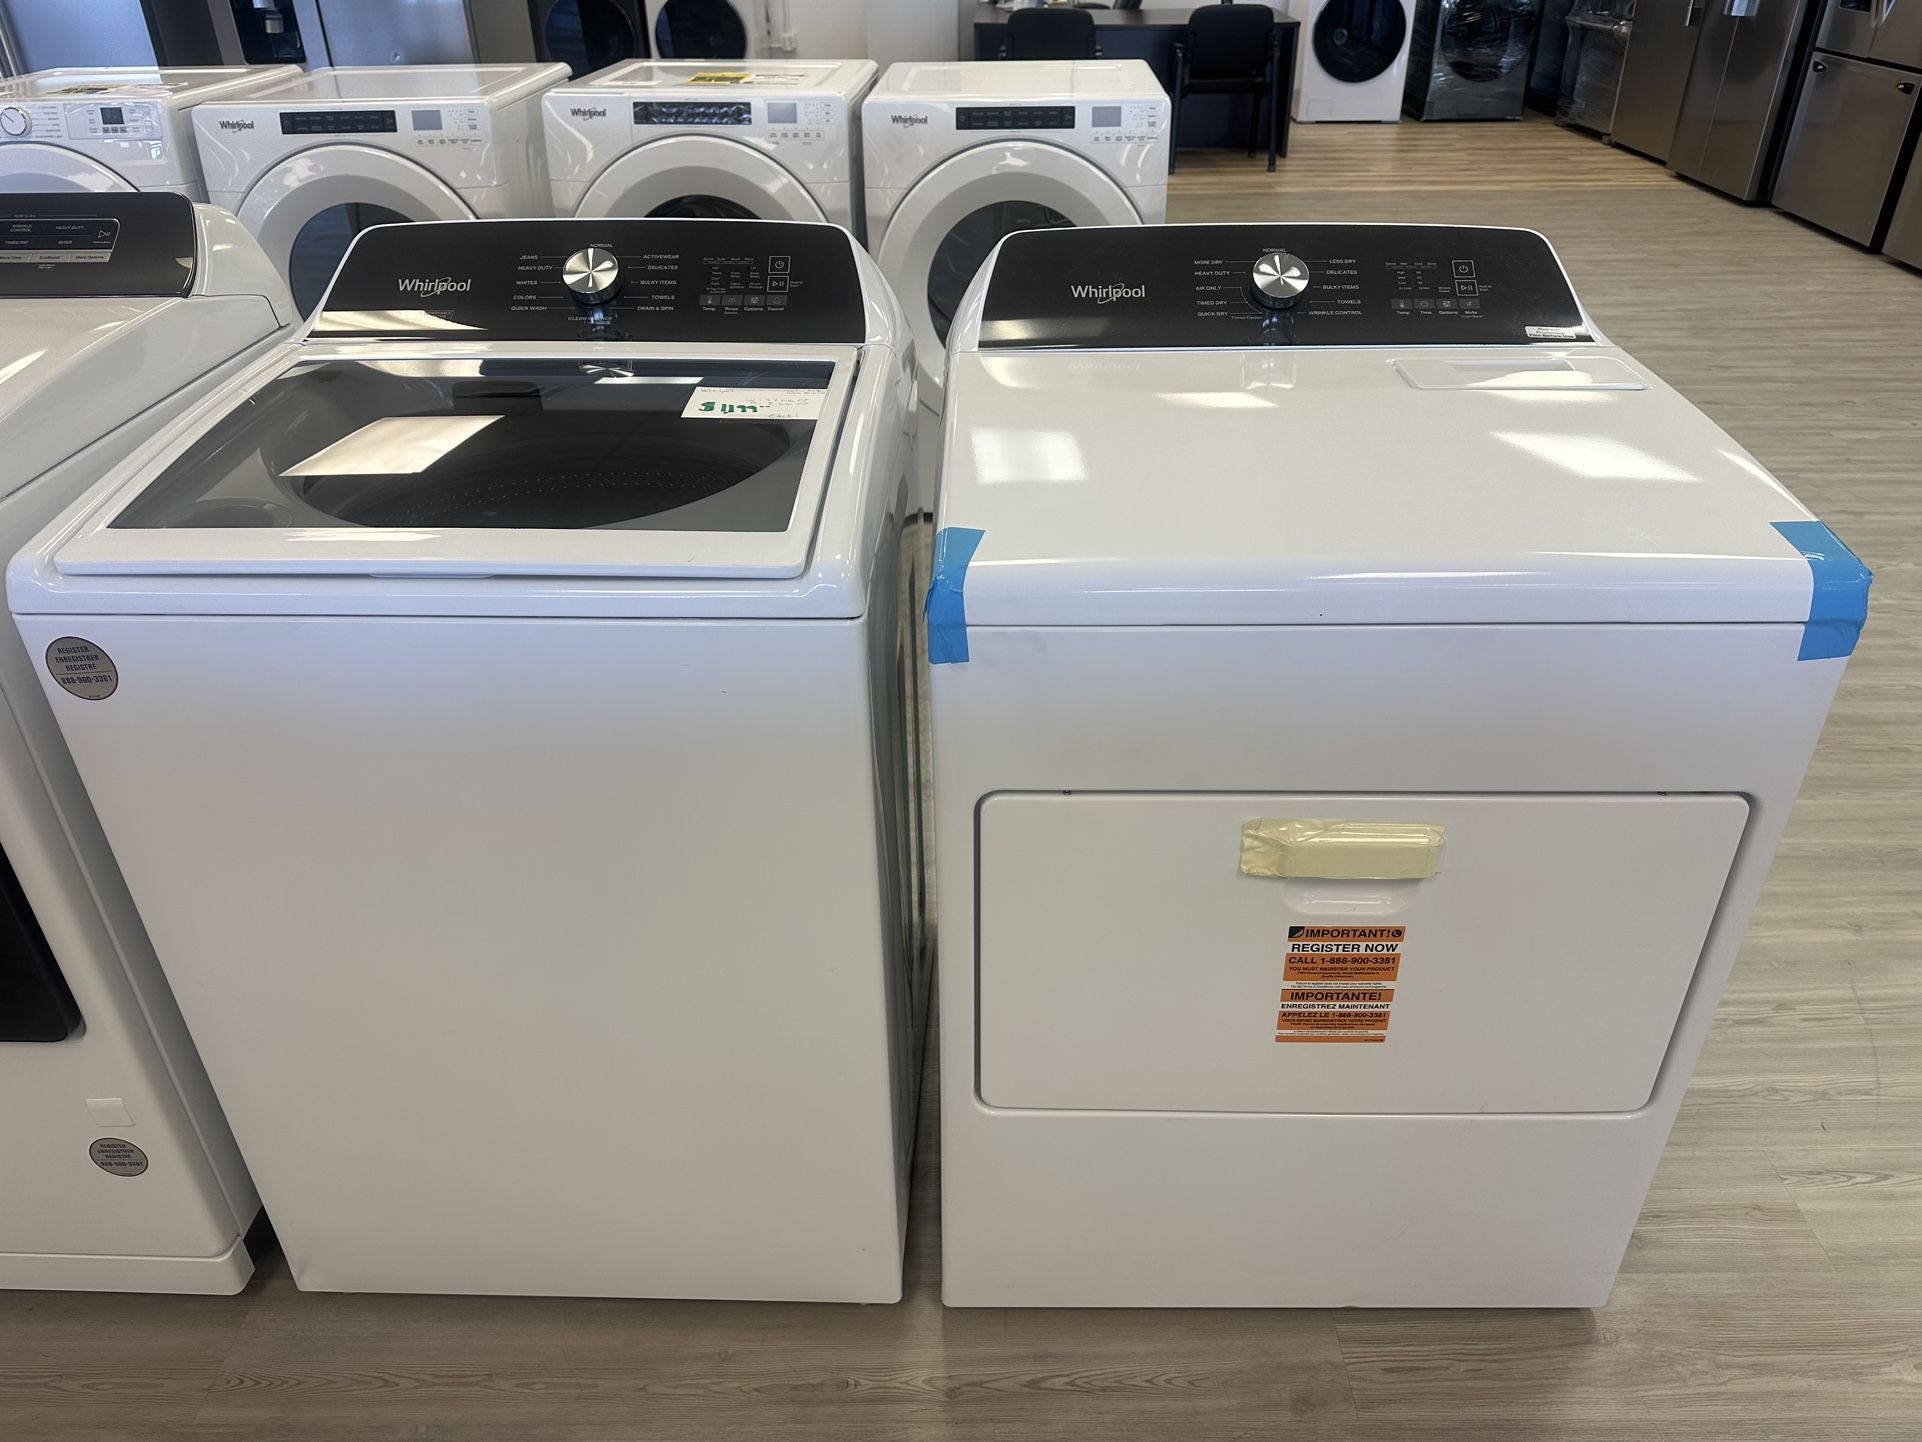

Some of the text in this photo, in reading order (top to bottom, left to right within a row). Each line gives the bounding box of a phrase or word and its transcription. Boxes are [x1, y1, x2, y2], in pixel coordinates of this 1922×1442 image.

[570, 107, 606, 120] Whirlpool
[890, 114, 928, 128] Whirlpool
[219, 120, 254, 133] Whirlpool
[398, 279, 471, 294] Whirlpool
[1071, 285, 1145, 301] Whirlpool
[57, 646, 89, 654] REGISTER
[55, 655, 99, 663] ENREGISTRER
[61, 675, 113, 684] 888-900-3381
[1305, 929, 1390, 938] IMPORTANT!
[1291, 944, 1398, 952] REGISTER NOW
[1290, 992, 1382, 1000] IMPORTANTE!
